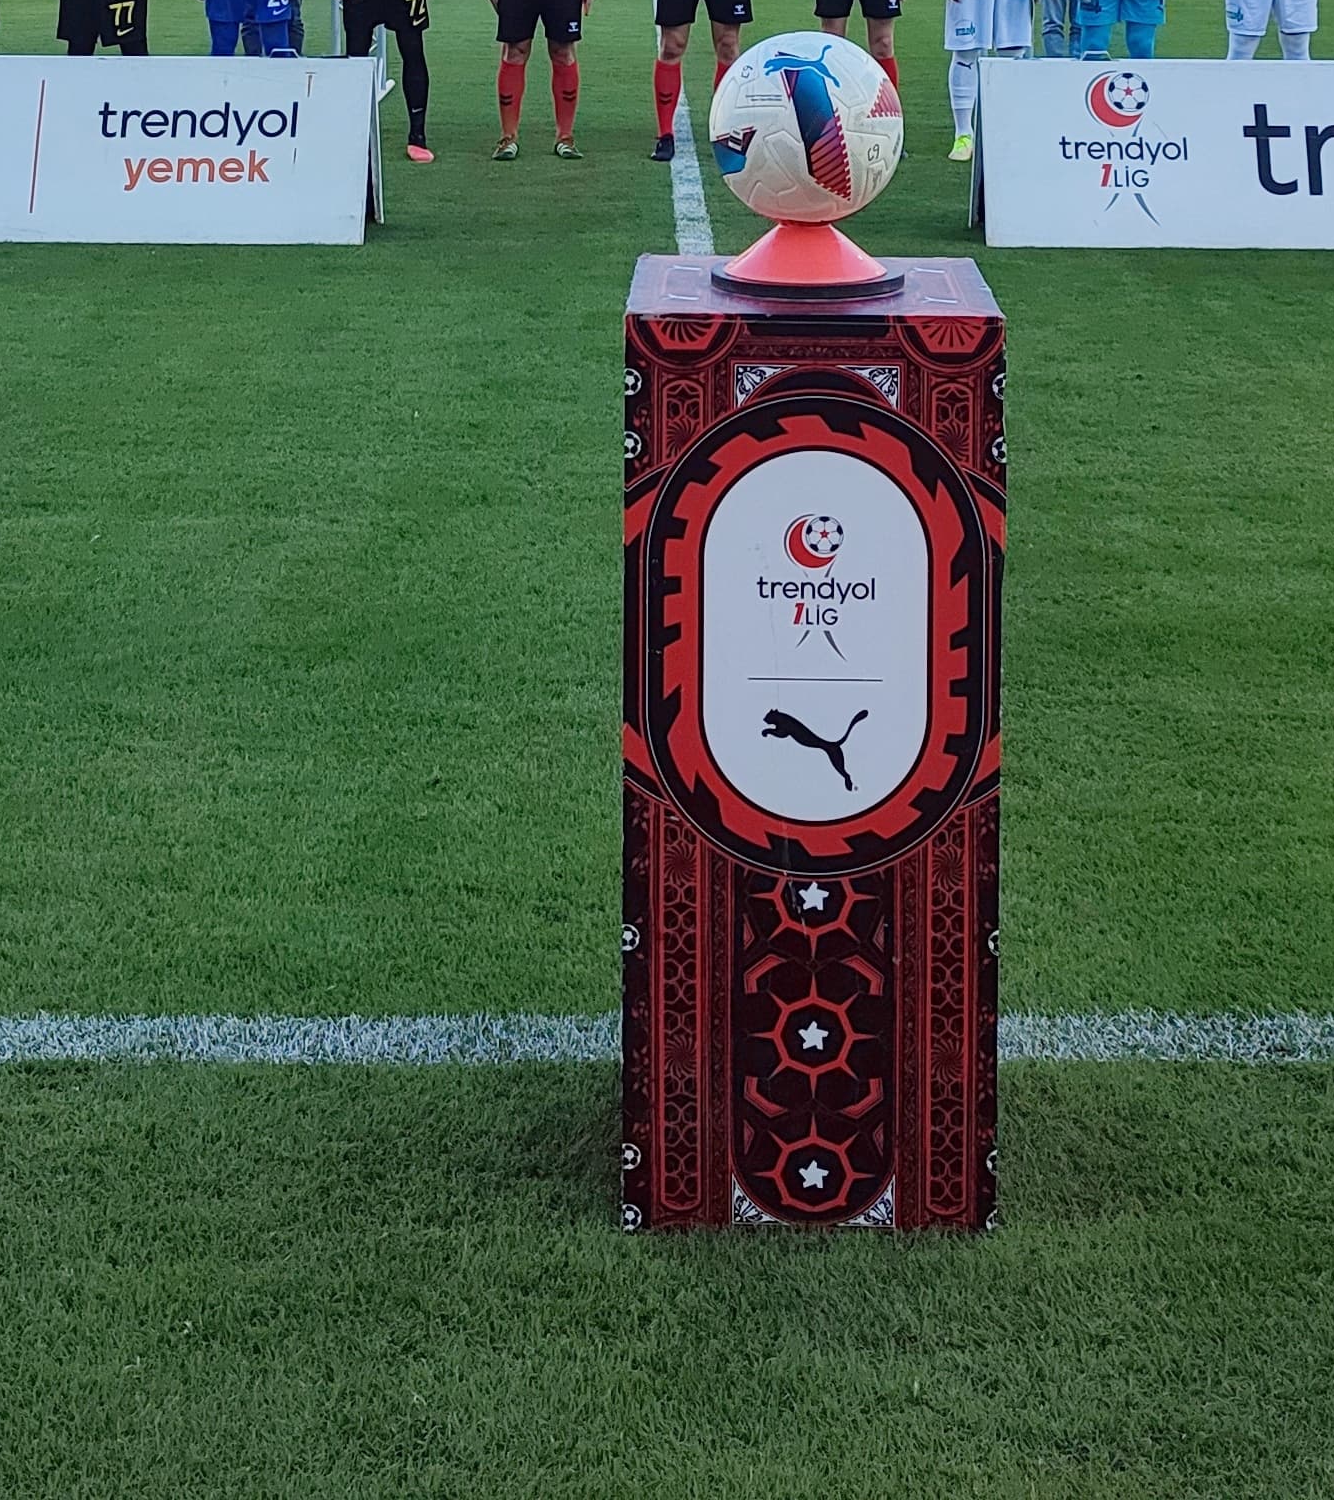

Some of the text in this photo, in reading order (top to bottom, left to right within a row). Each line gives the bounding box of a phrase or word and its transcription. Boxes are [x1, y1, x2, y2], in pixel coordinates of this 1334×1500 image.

[108, 0, 136, 28] 77
[98, 100, 299, 147] trendyol
[1058, 134, 1188, 167] trendyol
[123, 149, 270, 192] yemek
[756, 573, 876, 605] trendyol
